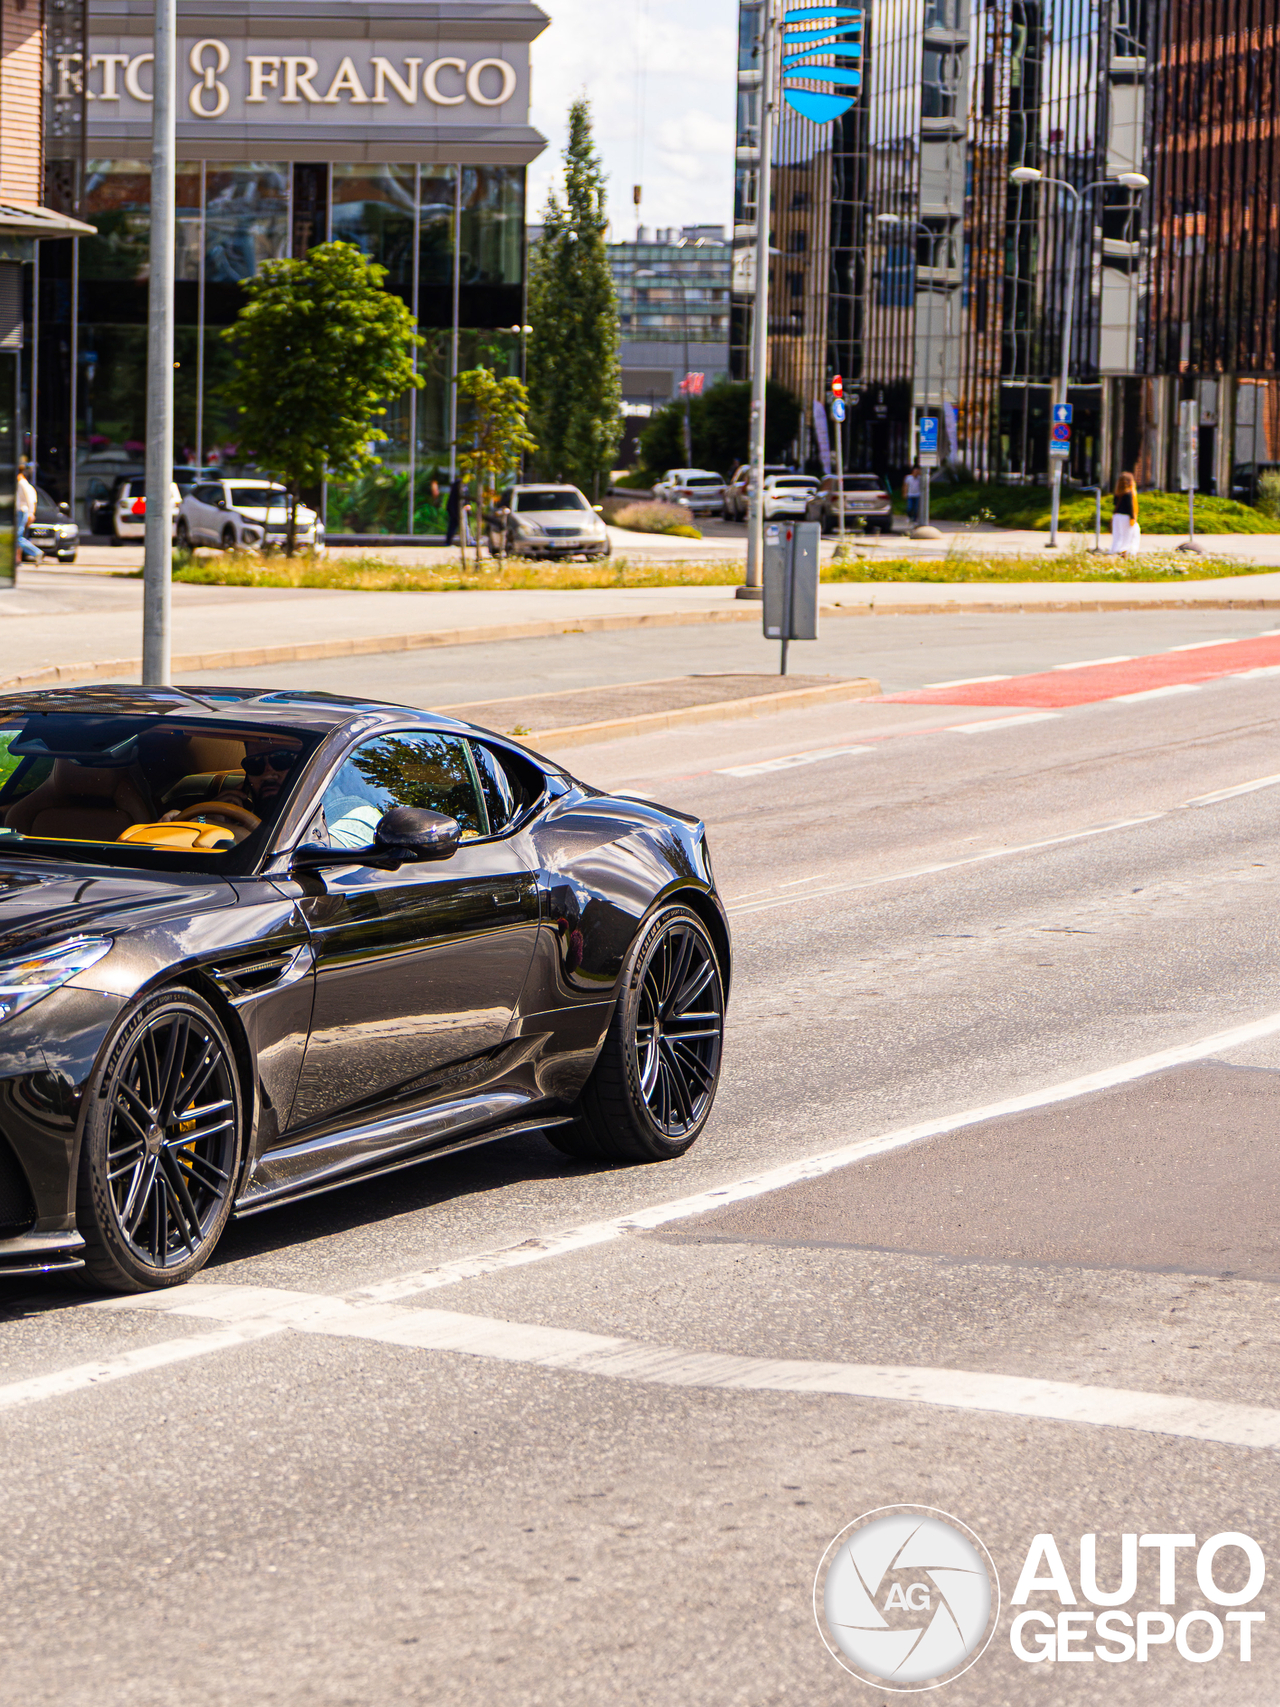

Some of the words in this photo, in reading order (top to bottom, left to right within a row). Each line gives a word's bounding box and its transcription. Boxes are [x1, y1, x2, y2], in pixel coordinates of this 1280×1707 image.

[245, 55, 517, 105] FRANCO
[635, 920, 661, 972] MICHELIN
[107, 1010, 144, 1077] MICHELIN
